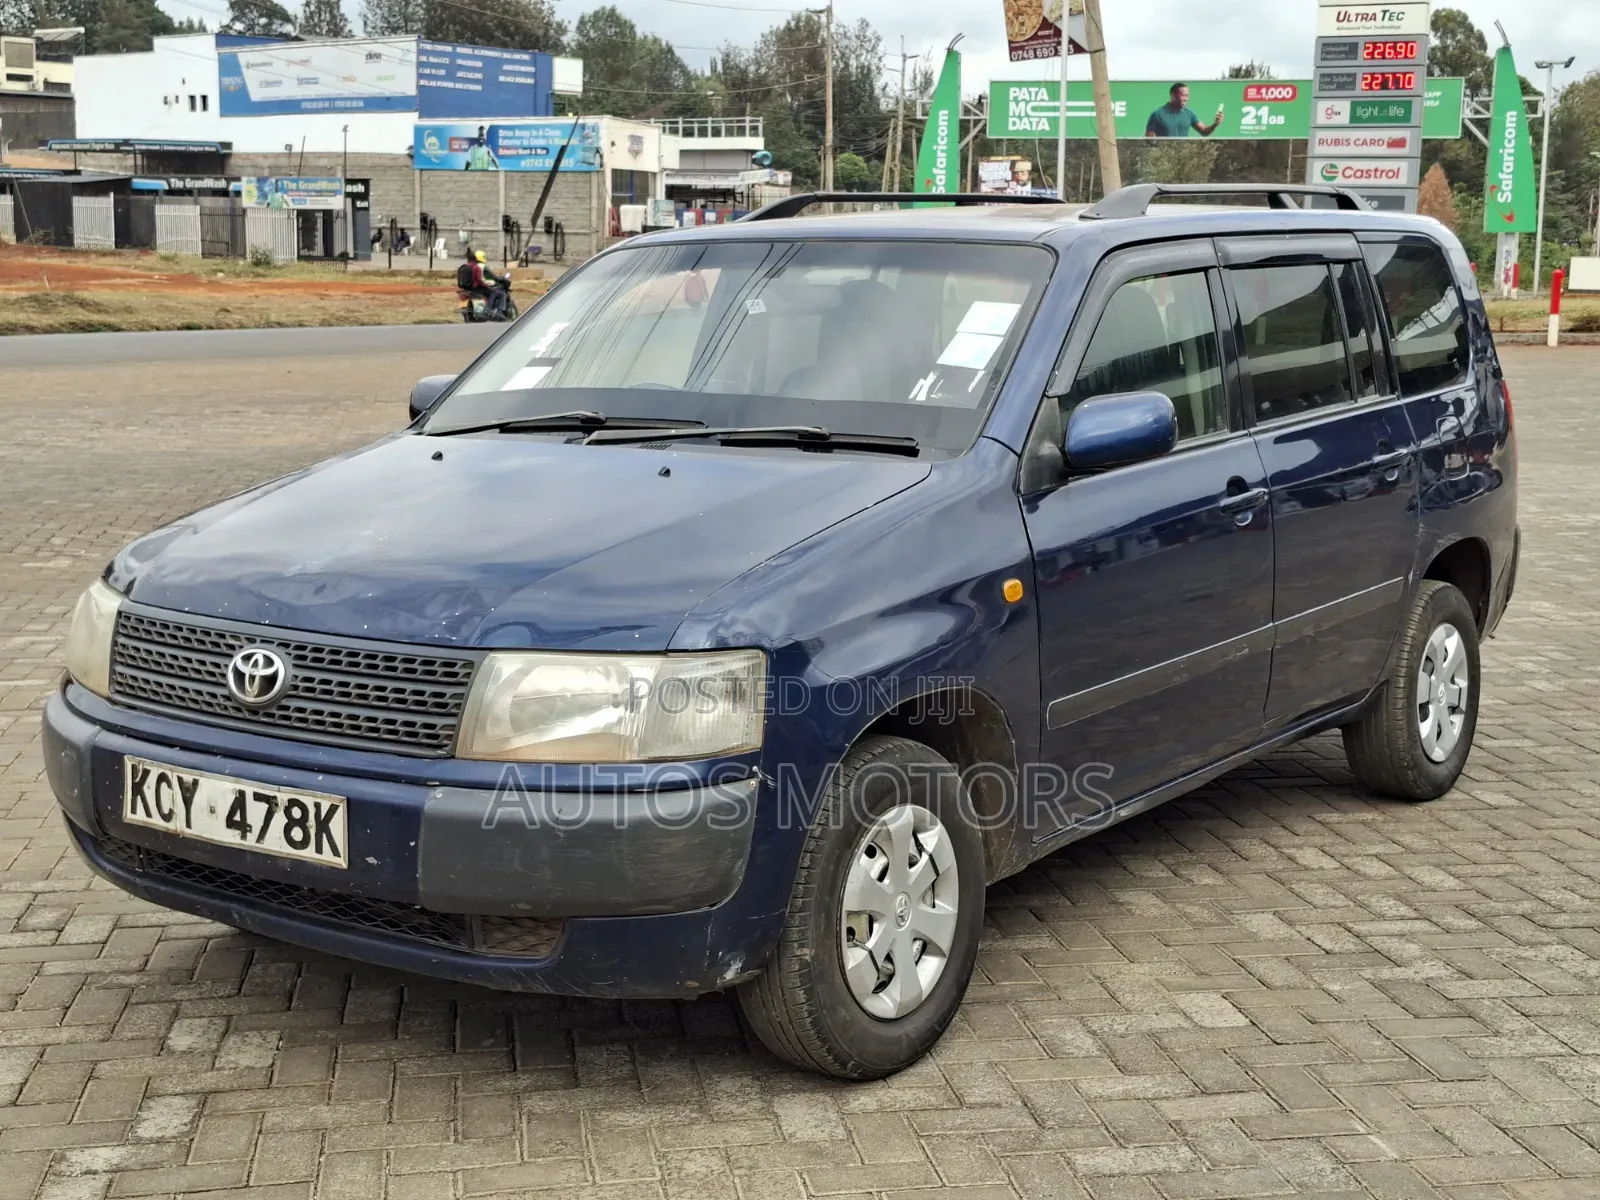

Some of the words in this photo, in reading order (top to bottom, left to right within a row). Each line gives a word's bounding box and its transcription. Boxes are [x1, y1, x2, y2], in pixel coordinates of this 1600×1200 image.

[1336, 11, 1377, 23] ULTRA
[1380, 9, 1405, 21] TEC
[1011, 51, 1035, 61] 0748
[1036, 48, 1055, 58] 690
[1056, 45, 1075, 55] 33
[1363, 42, 1417, 59] 226.90
[1320, 82, 1337, 90] Diesel
[1361, 73, 1415, 90] 227.70
[1009, 87, 1049, 101] PATA
[1260, 87, 1293, 101] 1,000
[1241, 105, 1269, 125] 21
[1269, 115, 1285, 125] GB
[1356, 106, 1378, 119] light
[1388, 105, 1404, 117] life
[1008, 117, 1050, 131] DATA
[1317, 138, 1351, 148] RUBIS
[1353, 138, 1386, 148] CARD
[932, 110, 950, 194] Safaricom
[1497, 111, 1518, 204] Safaricom
[1342, 166, 1402, 180] Castrol
[169, 178, 184, 189] The
[185, 178, 227, 189] GrandWash
[284, 180, 298, 191] The
[130, 763, 200, 830] KCY
[225, 788, 341, 858] 478K
